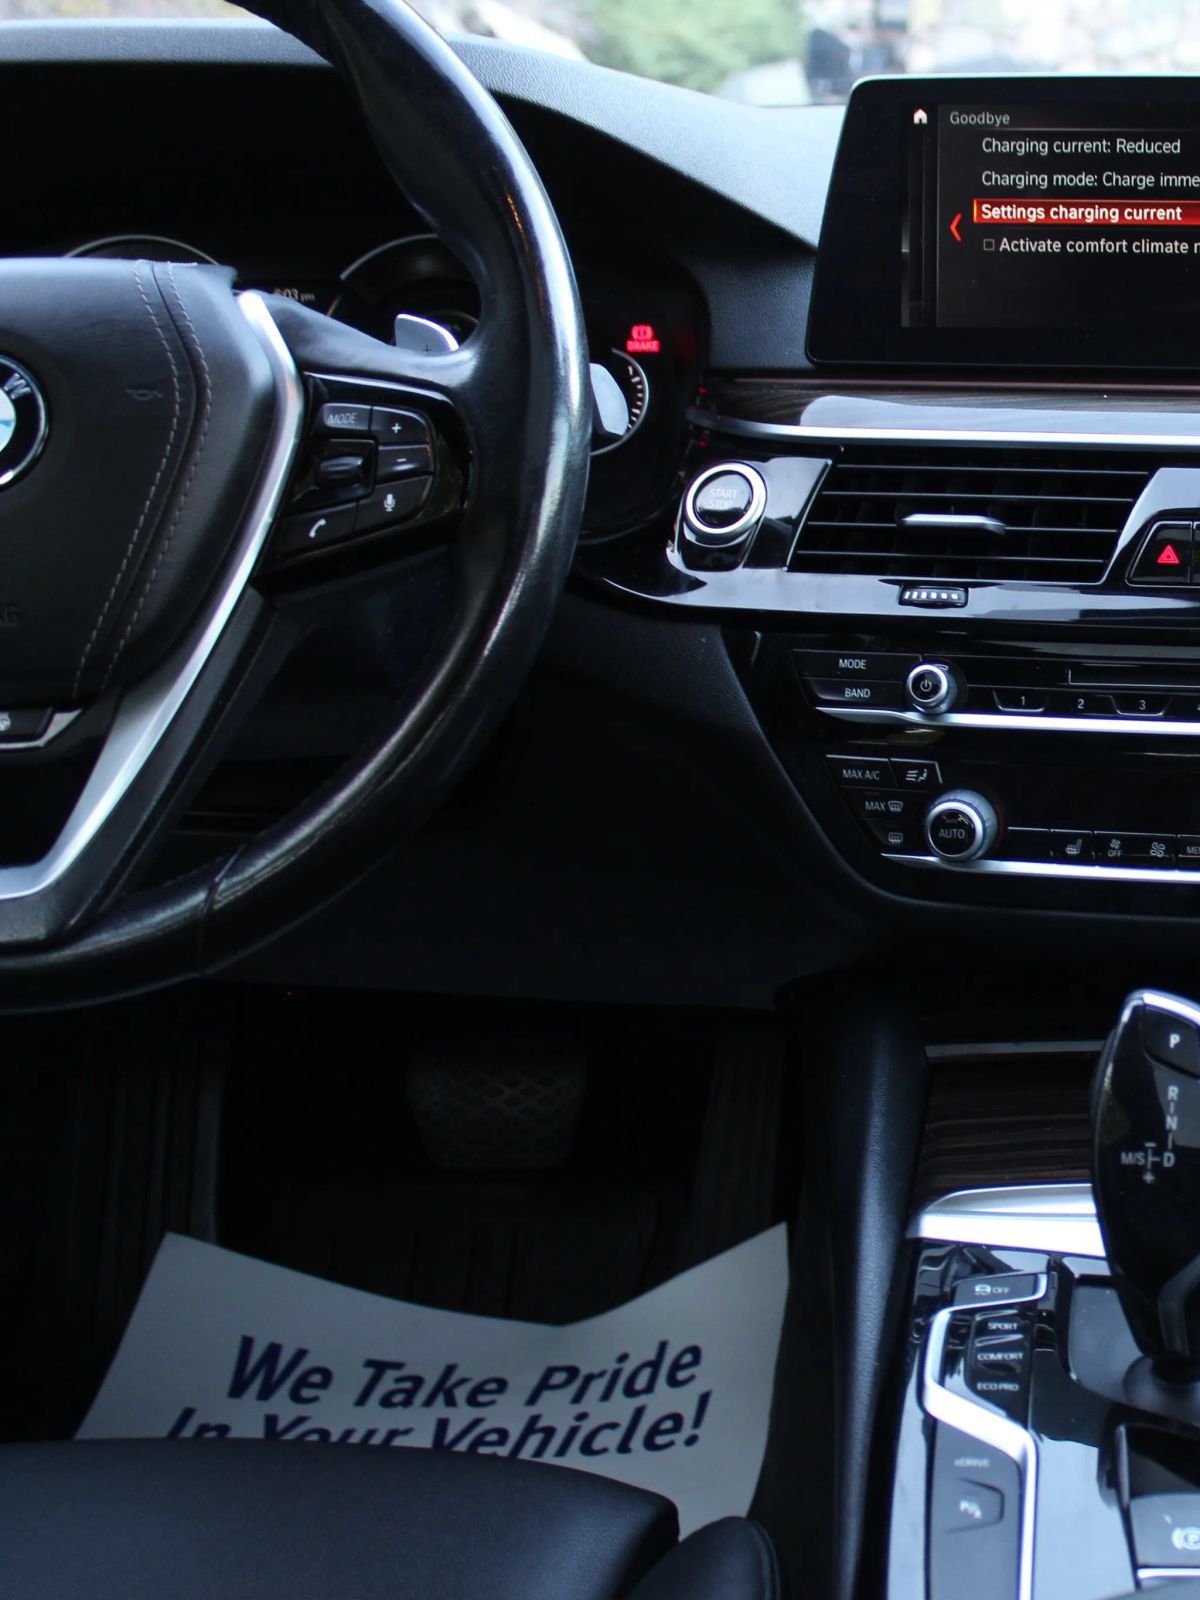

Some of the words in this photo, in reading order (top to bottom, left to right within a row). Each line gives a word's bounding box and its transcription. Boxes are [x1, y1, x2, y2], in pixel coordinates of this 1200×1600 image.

[950, 112, 1010, 127] Goodbye
[982, 138, 1048, 155] Charging
[1053, 139, 1111, 153] current:
[1116, 138, 1181, 153] Reduced
[981, 171, 1048, 188] Charging
[1053, 172, 1098, 186] mode:
[1102, 172, 1155, 189] Charge
[981, 204, 1045, 222] Settings
[1049, 205, 1119, 223] charging
[1124, 206, 1182, 220] current
[999, 237, 1061, 252] Activate
[1066, 238, 1128, 253] comfort
[1132, 239, 1189, 254] climate
[626, 340, 660, 353] BRAKE
[327, 412, 358, 424] MODE
[838, 658, 867, 671] MODE
[844, 687, 871, 699] BAND
[1077, 699, 1085, 710] 2
[1139, 700, 1147, 711] 3
[842, 769, 863, 780] MAX
[864, 770, 881, 781] A/C
[864, 801, 887, 811] MAX
[938, 828, 966, 839] AUTO
[1169, 1033, 1181, 1049] P
[1168, 1085, 1179, 1101] R
[1165, 1115, 1178, 1131] N
[1120, 1152, 1145, 1165] M/S
[1163, 1152, 1175, 1168] D
[987, 1321, 1018, 1331] SPORT
[977, 1352, 1024, 1362] COMFORT
[227, 1335, 334, 1405] We
[353, 1359, 509, 1409] Take
[524, 1341, 702, 1407] Pride
[977, 1382, 999, 1392] ECO
[1000, 1382, 1020, 1392] PRO
[432, 1390, 712, 1458] Vehicle!
